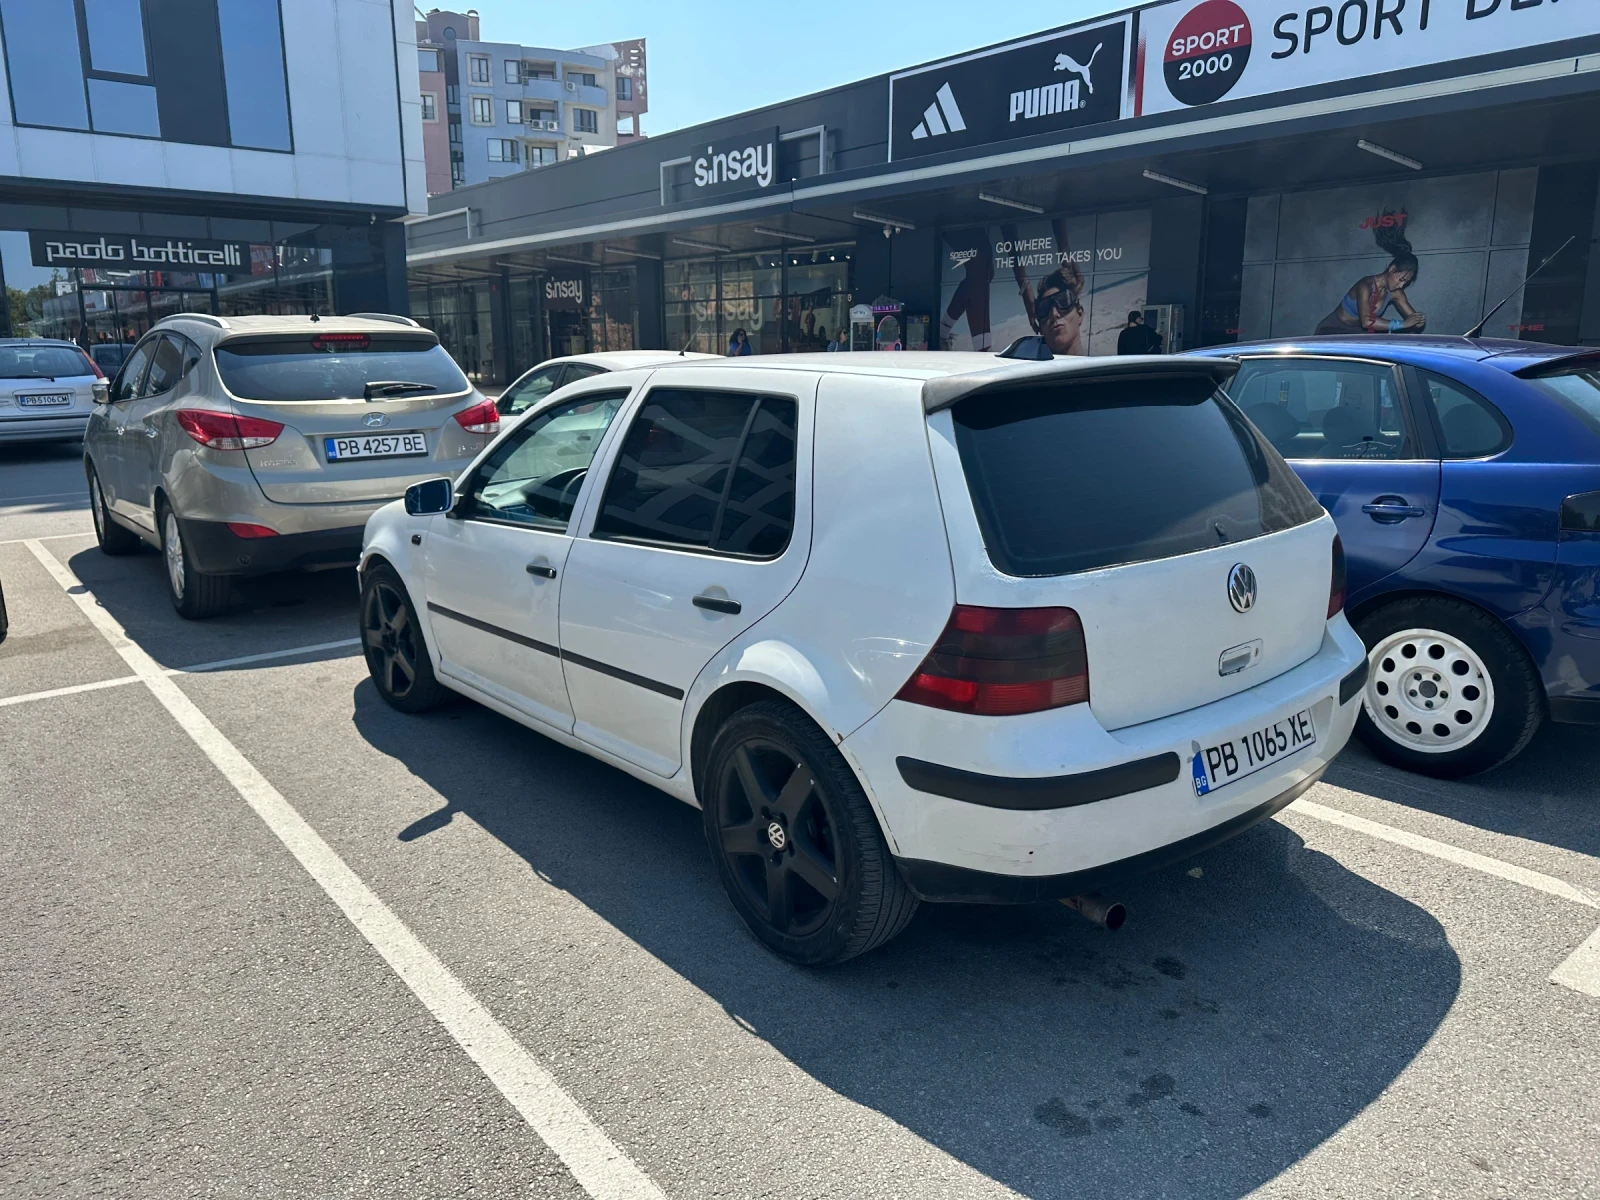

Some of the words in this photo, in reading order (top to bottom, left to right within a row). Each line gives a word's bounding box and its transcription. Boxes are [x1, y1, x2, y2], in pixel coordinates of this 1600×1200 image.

[1171, 24, 1245, 56] SPORT
[1178, 53, 1233, 80] 2000
[1009, 79, 1080, 122] PUMA
[694, 143, 773, 188] sinsay
[1359, 213, 1408, 229] JUST
[46, 237, 125, 262] paolo
[131, 239, 241, 266] botticelli
[949, 248, 977, 260] speedo
[995, 241, 1012, 254] GO
[1014, 237, 1052, 252] WHERE
[995, 257, 1014, 269] THE
[1017, 253, 1053, 267] WATER
[1056, 250, 1091, 264] TAKES
[1096, 248, 1122, 261] YOU
[545, 276, 583, 304] sinsay
[26, 397, 37, 405] PB
[37, 396, 56, 404] 5106
[56, 395, 68, 403] CM
[338, 439, 360, 457] PB
[363, 437, 400, 455] 4257
[404, 436, 424, 452] BE
[1206, 742, 1239, 783] PB
[1242, 721, 1288, 767] 1065
[1287, 709, 1312, 747] XE
[1195, 775, 1207, 789] BG
